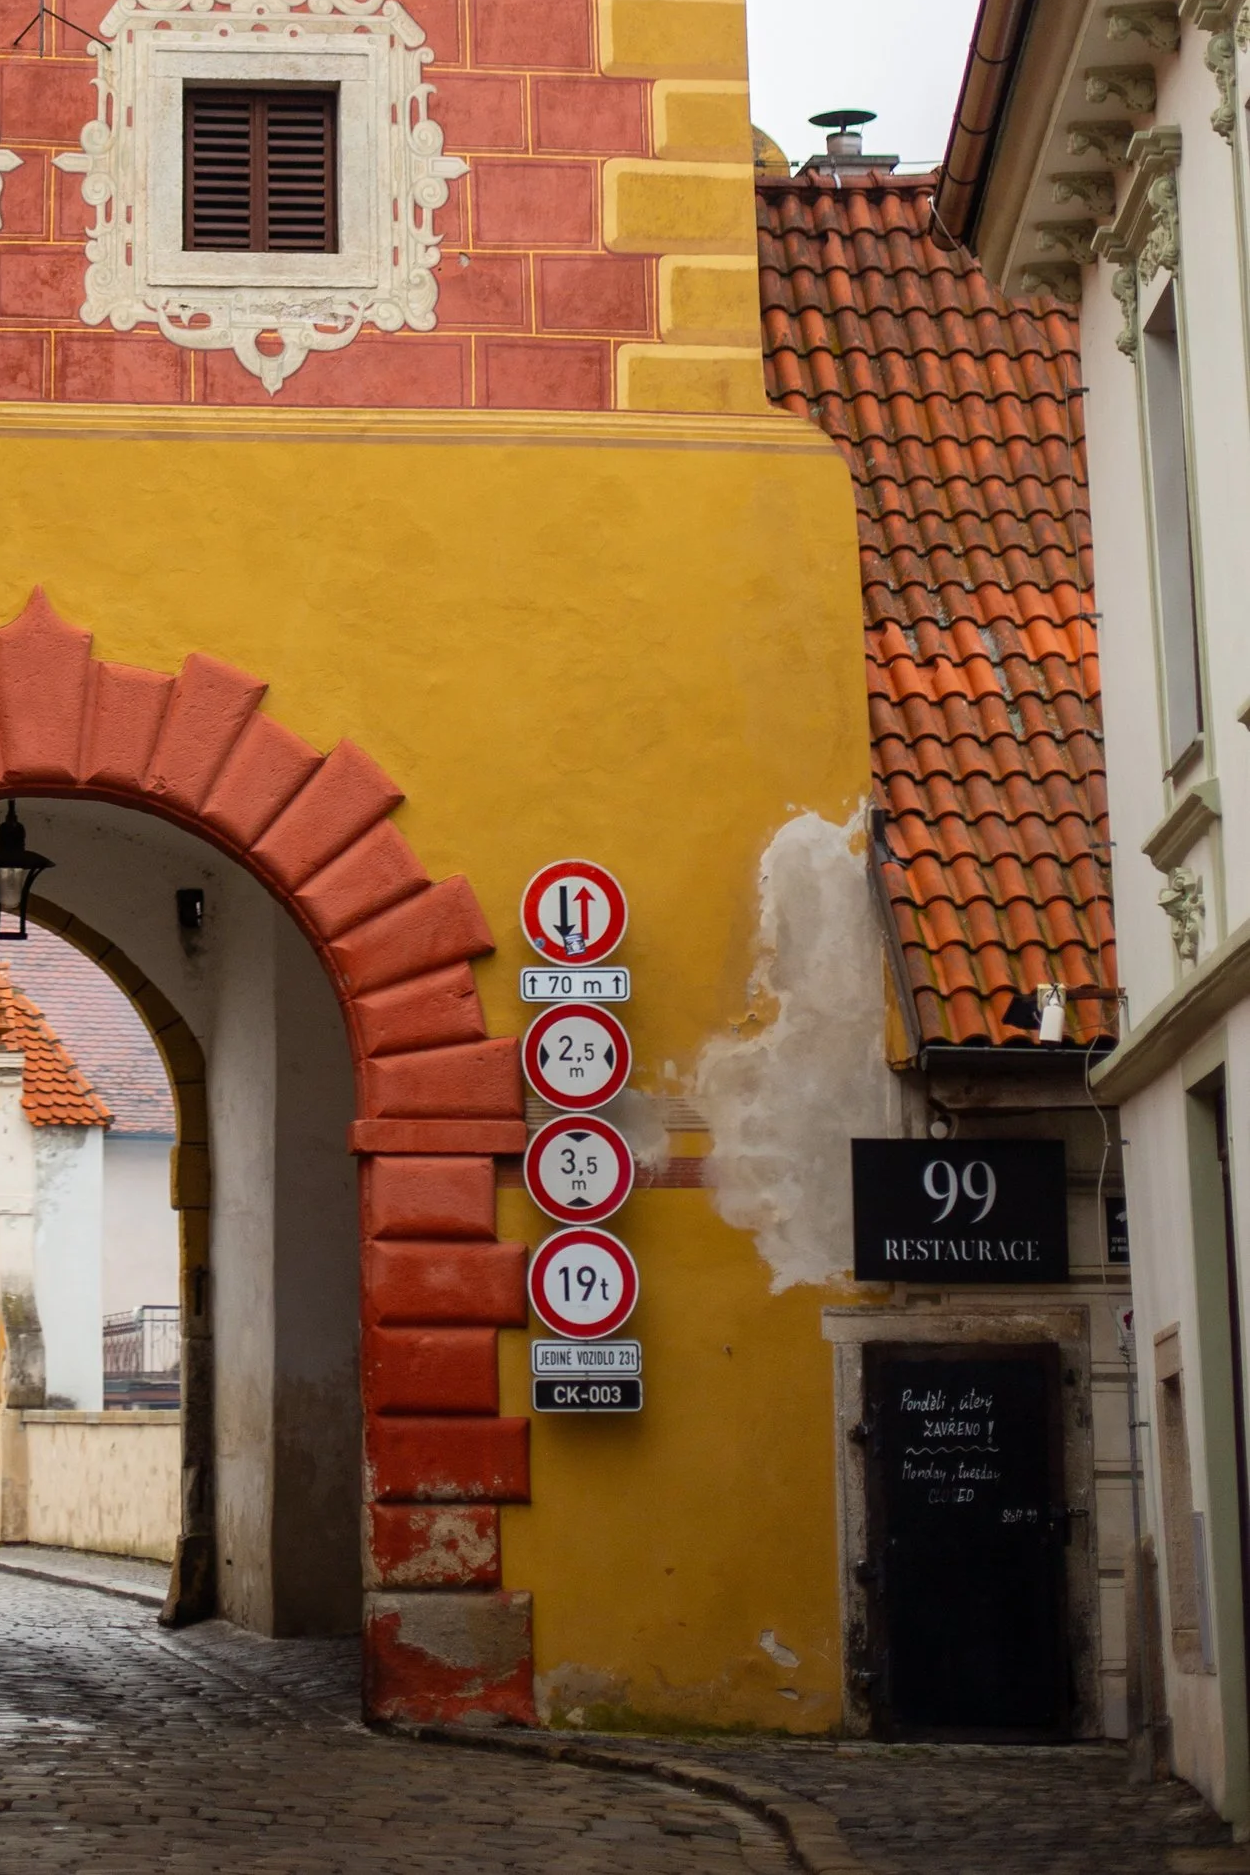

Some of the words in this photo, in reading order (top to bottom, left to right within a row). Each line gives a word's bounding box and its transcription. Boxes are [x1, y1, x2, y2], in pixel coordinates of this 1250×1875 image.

[548, 976, 573, 994] 70
[583, 979, 602, 994] m
[558, 1035, 595, 1063] 2,5
[569, 1066, 584, 1078] m
[560, 1148, 598, 1177] 3,5
[571, 1178, 587, 1191] m
[923, 1160, 997, 1224] 99
[885, 1239, 1041, 1262] RESTAURACE
[539, 1348, 572, 1366] JEDINÉ
[576, 1351, 615, 1366] VOZIDLO
[619, 1351, 635, 1366] 23t
[553, 1386, 622, 1404] CK-003
